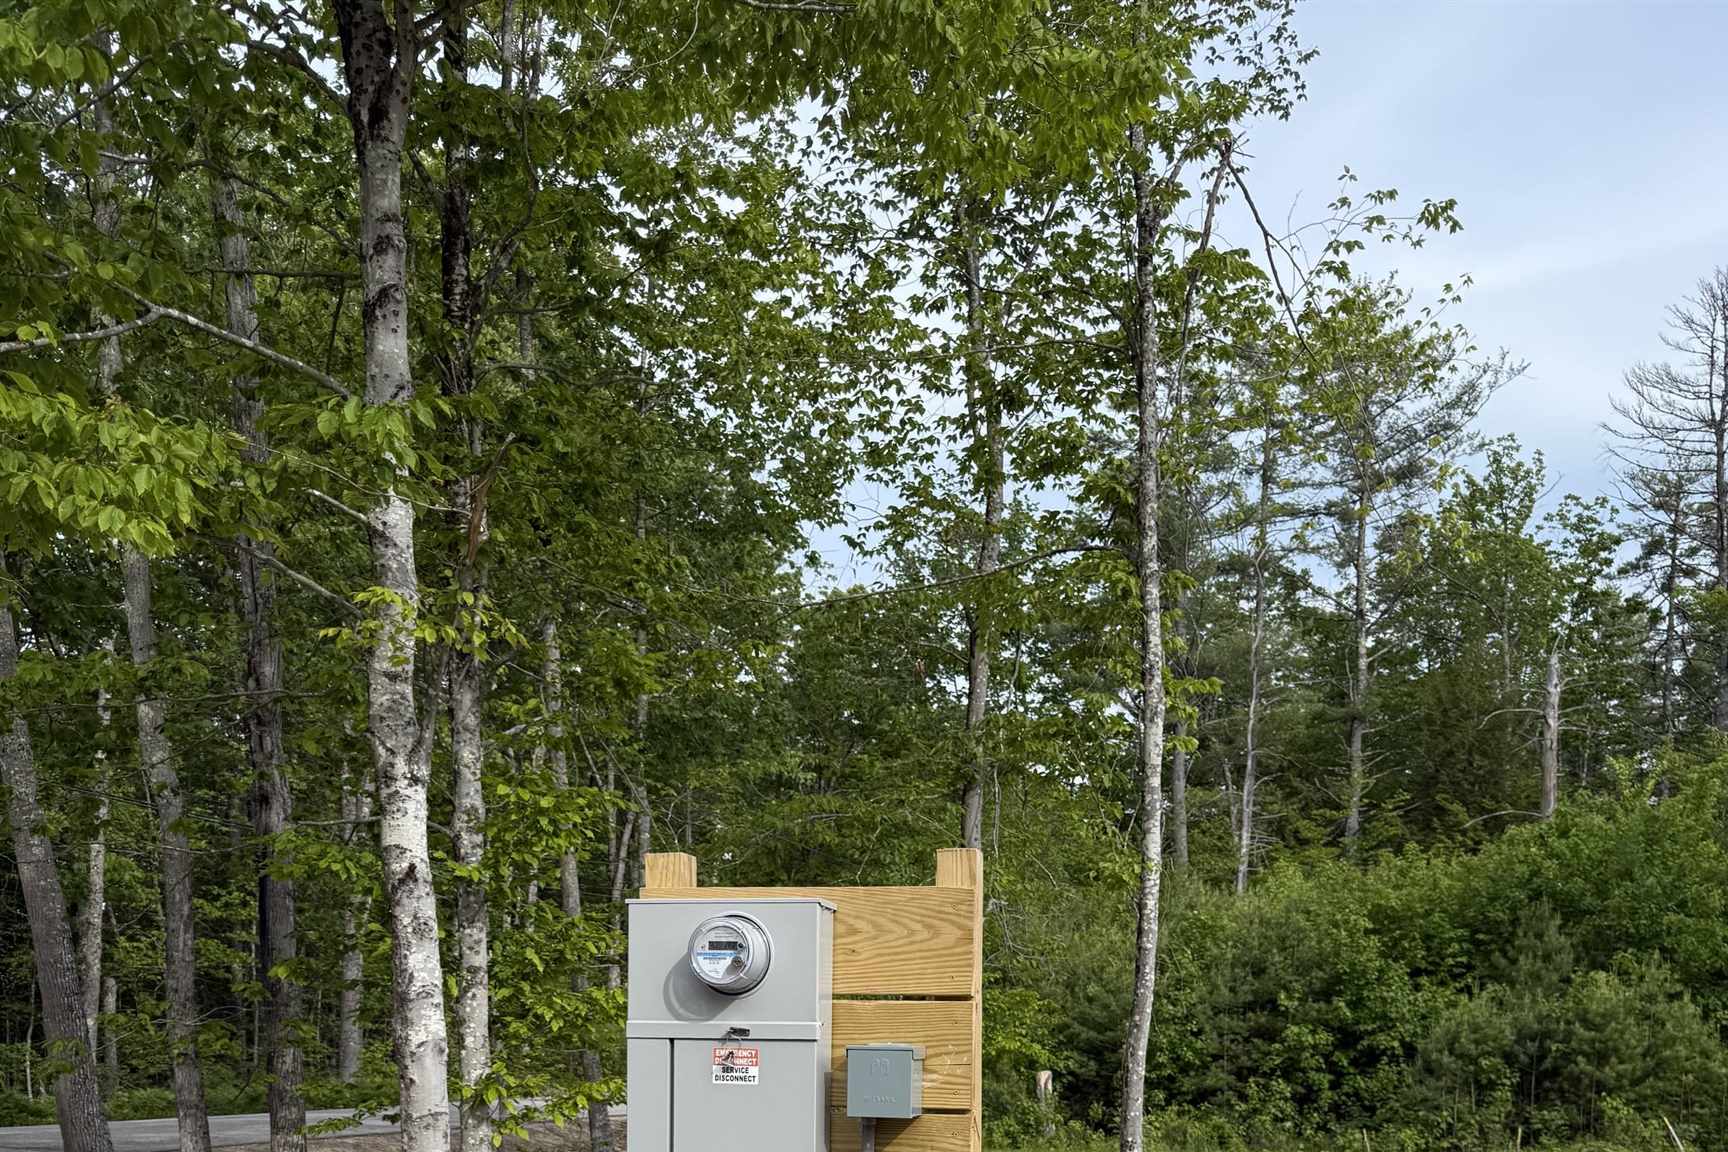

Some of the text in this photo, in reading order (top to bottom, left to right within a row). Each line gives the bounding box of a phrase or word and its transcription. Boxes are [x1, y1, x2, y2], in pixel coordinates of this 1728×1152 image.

[716, 1049, 756, 1057] EMGENCY
[714, 1057, 757, 1065] DINNECT
[721, 1066, 749, 1074] SERVICE
[714, 1074, 756, 1083] DISCONNECT
